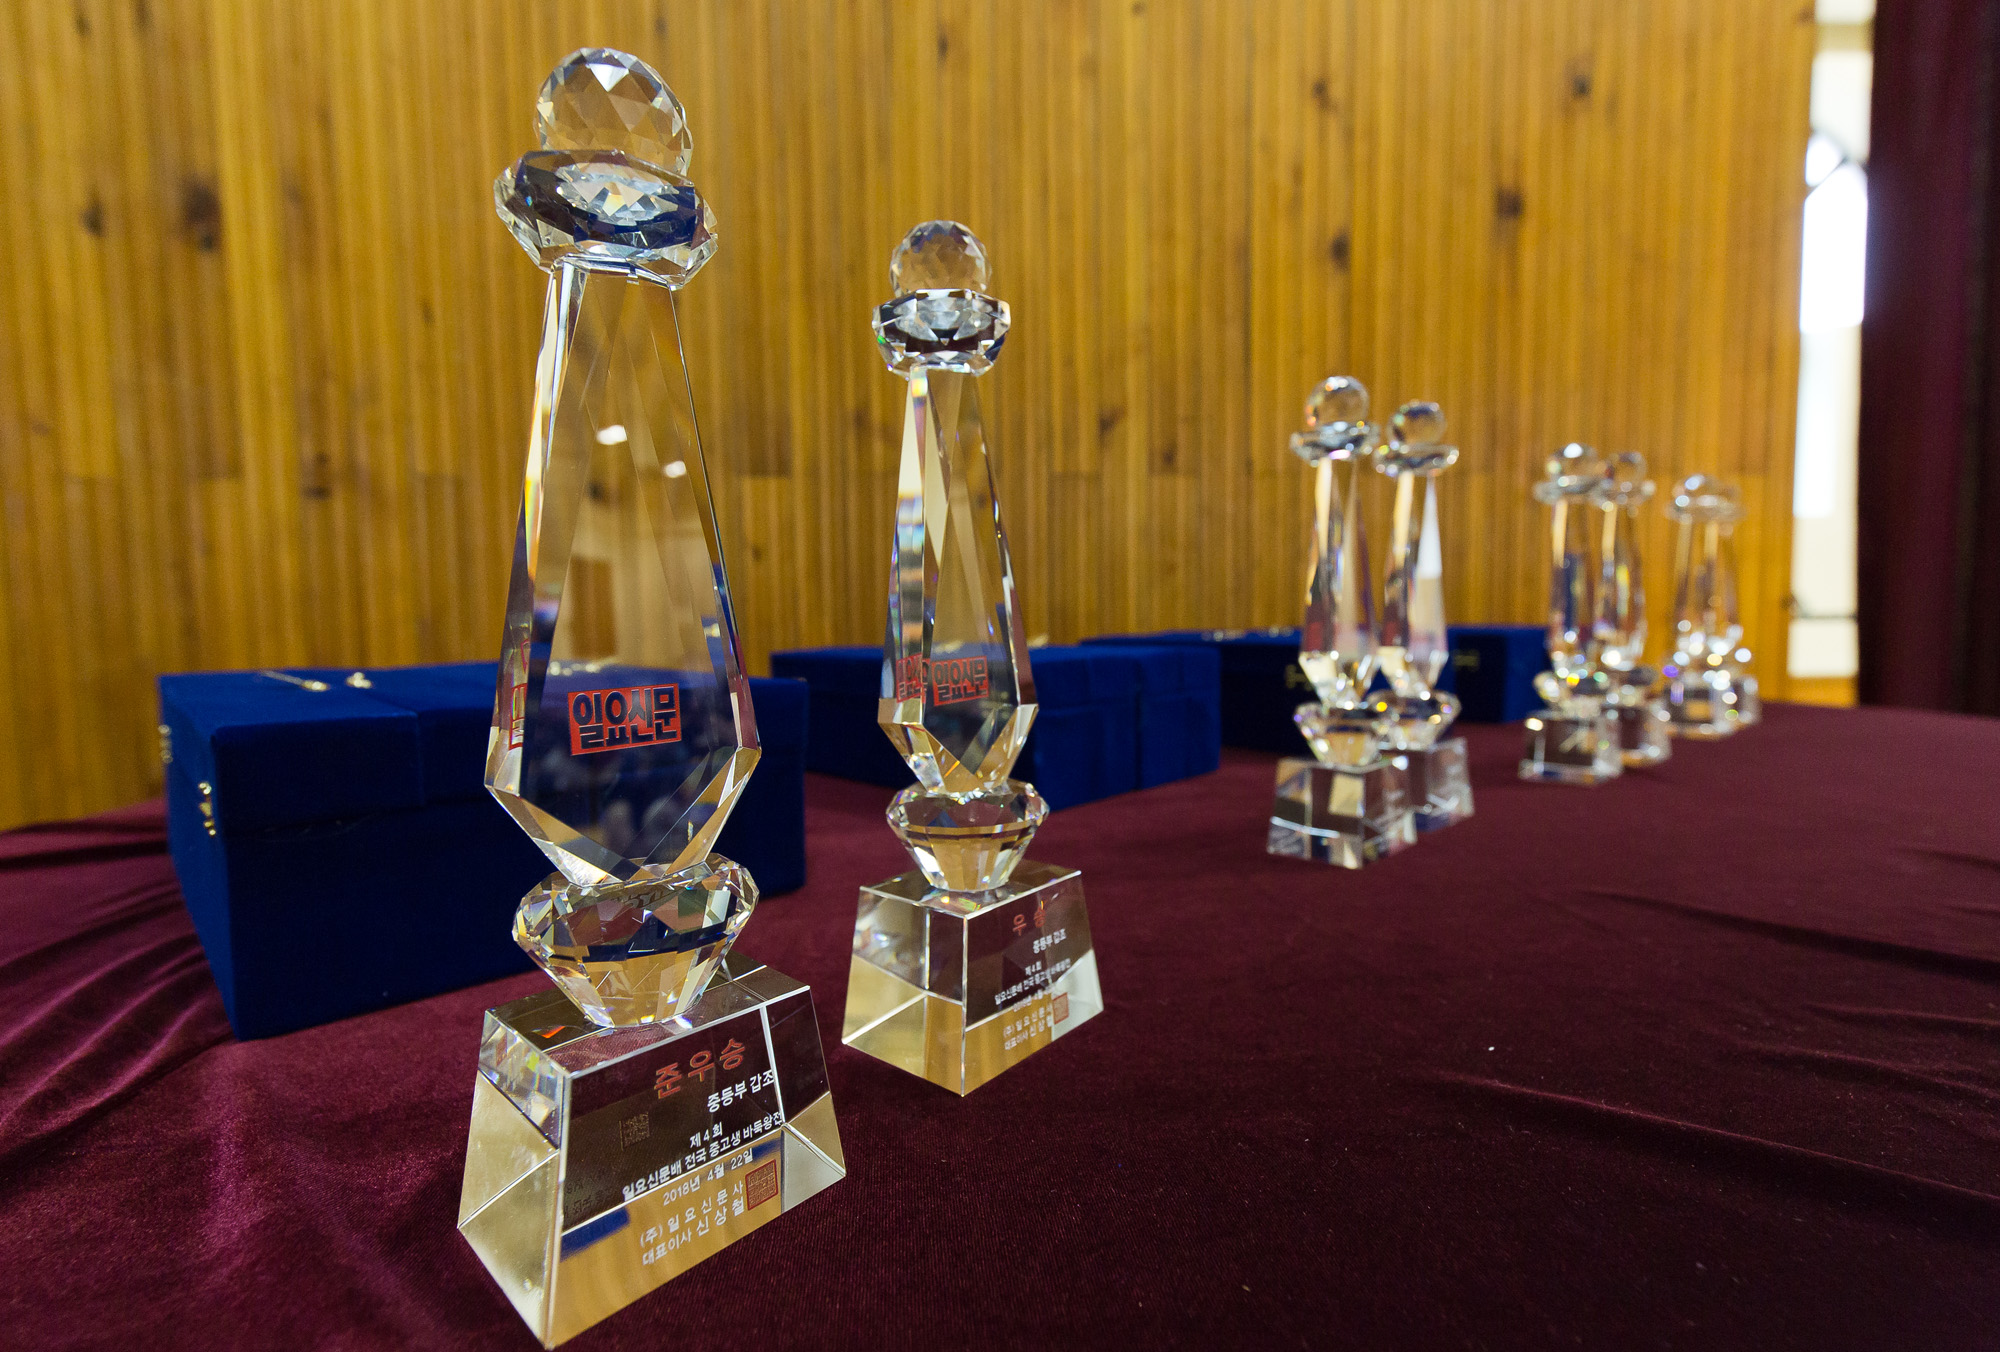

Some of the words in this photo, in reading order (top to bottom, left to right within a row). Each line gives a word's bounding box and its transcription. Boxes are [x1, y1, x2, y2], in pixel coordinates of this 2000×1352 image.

[933, 657, 986, 703] 일요신문
[572, 685, 679, 752] 일요신문
[707, 1080, 747, 1113] 중등부
[749, 1069, 775, 1093] 갑조
[622, 1159, 682, 1201] 일요신문배
[684, 1152, 707, 1170] 전국
[709, 1129, 741, 1157] 중고생
[743, 1111, 783, 1140] 바둑왕전
[663, 1175, 701, 1206] 2018년
[707, 1162, 725, 1182] 4월
[731, 1147, 754, 1170] 22일
[640, 1224, 663, 1248] (주)
[642, 1228, 692, 1266] 대표이사
